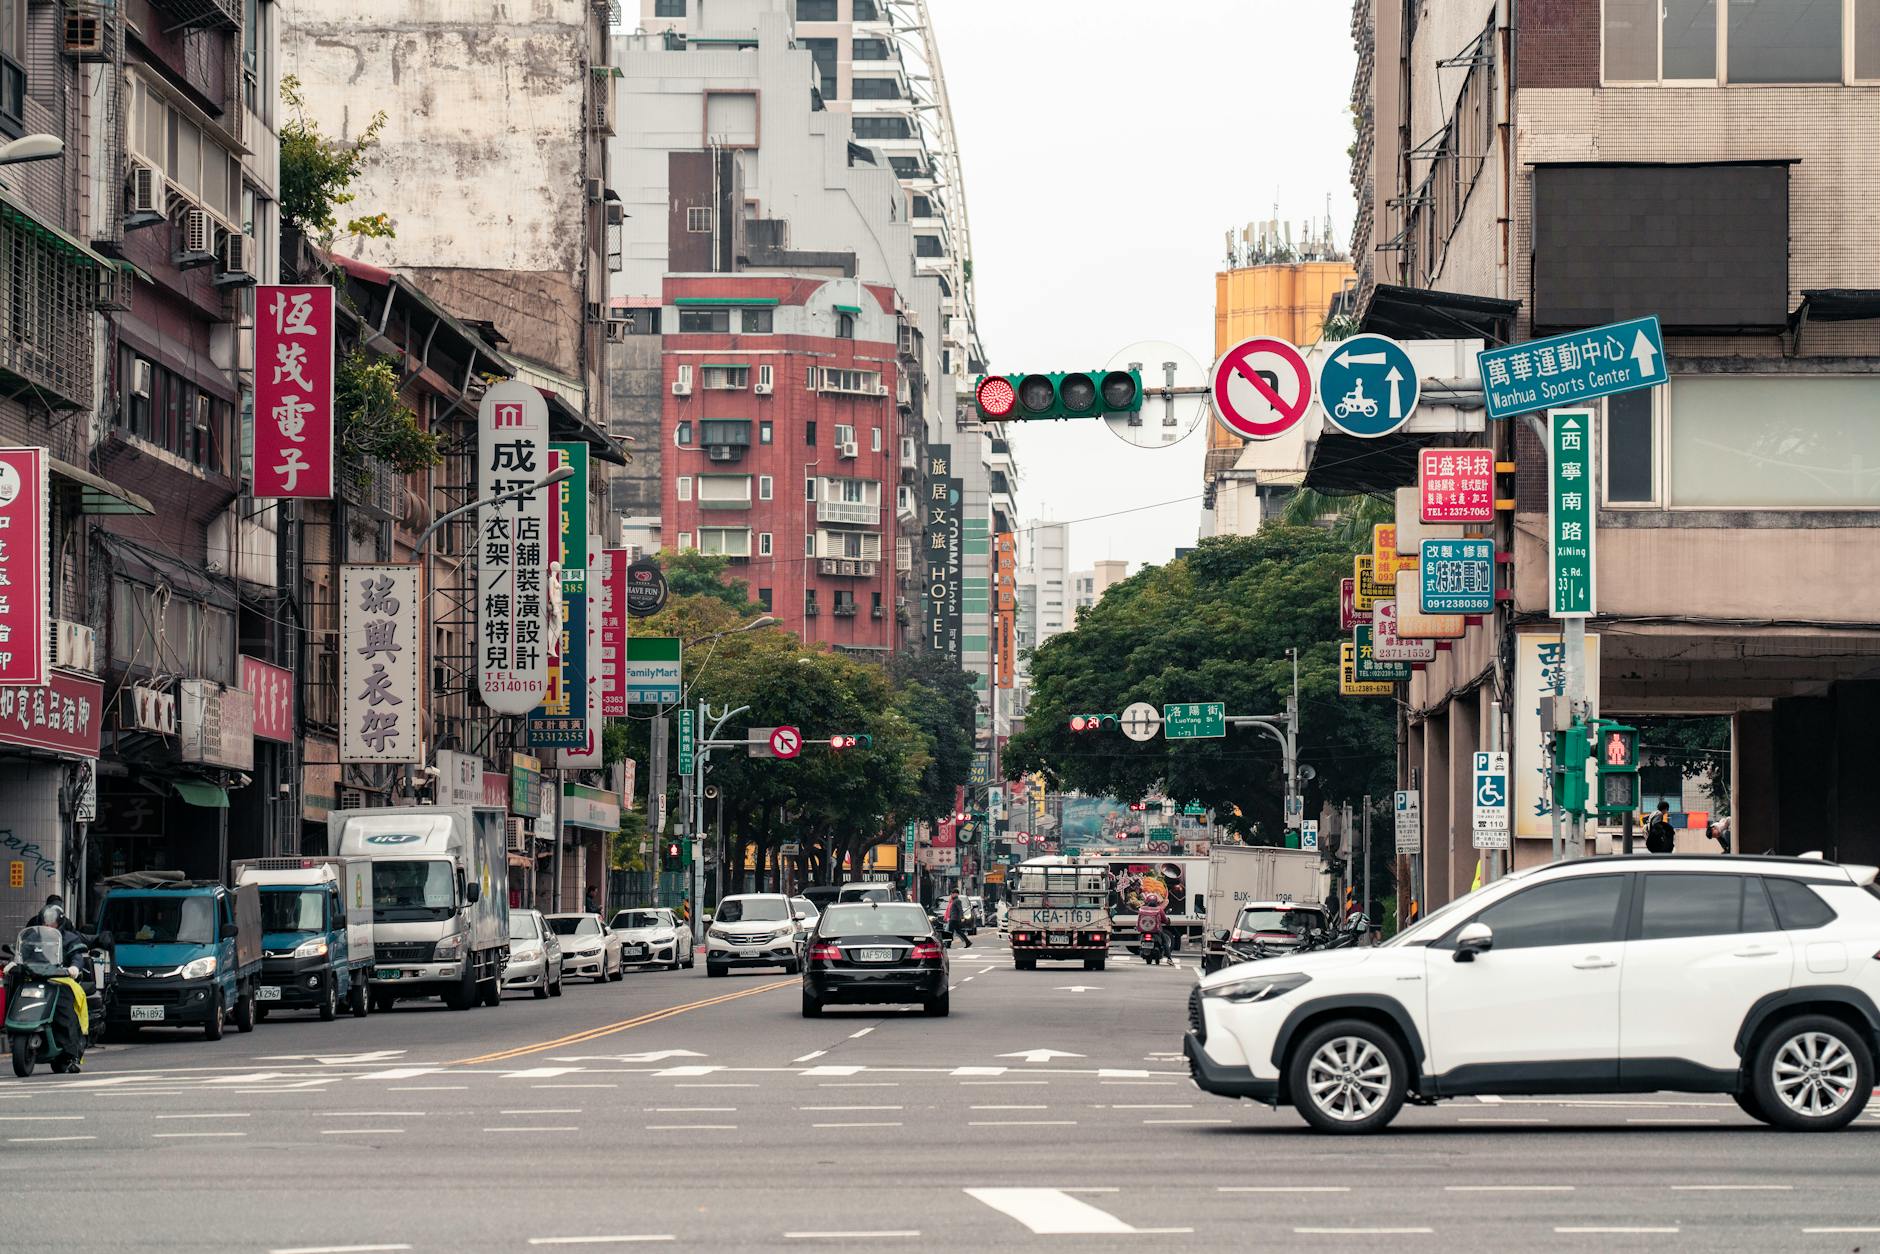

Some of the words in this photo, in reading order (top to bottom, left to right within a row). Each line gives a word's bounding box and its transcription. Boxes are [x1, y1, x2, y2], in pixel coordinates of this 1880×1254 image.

[1485, 335, 1625, 389] 萬華運動中心
[1492, 388, 1536, 409] Wanhua
[1541, 377, 1585, 399] Sports
[1589, 369, 1631, 388] Center
[1426, 456, 1490, 476] 日盛科技
[490, 439, 537, 512] 成坪
[1561, 431, 1582, 541] 西寧南路
[931, 458, 947, 549] 旅居文旅
[949, 518, 959, 573] COMMA
[1557, 546, 1586, 558] XiNing
[1436, 560, 1490, 592] 特殊電池
[1570, 567, 1583, 577] Rd.
[516, 517, 541, 671] 店舖裝潢設計
[644, 588, 658, 596] FUN
[1579, 587, 1584, 600] 4
[931, 567, 947, 649] HOTEL
[1427, 599, 1490, 609] 0912380369
[1379, 649, 1430, 658] 2371-1552
[356, 573, 403, 752] 瑞興衣架
[485, 672, 518, 680] TEL
[627, 667, 678, 679] FamilyMart
[484, 680, 543, 692] 23140161
[1170, 705, 1219, 717] 洛陽街
[1087, 717, 1099, 728] 24
[531, 731, 584, 742] 23312355
[845, 736, 856, 746] 24
[1033, 910, 1092, 923] KEA-1169
